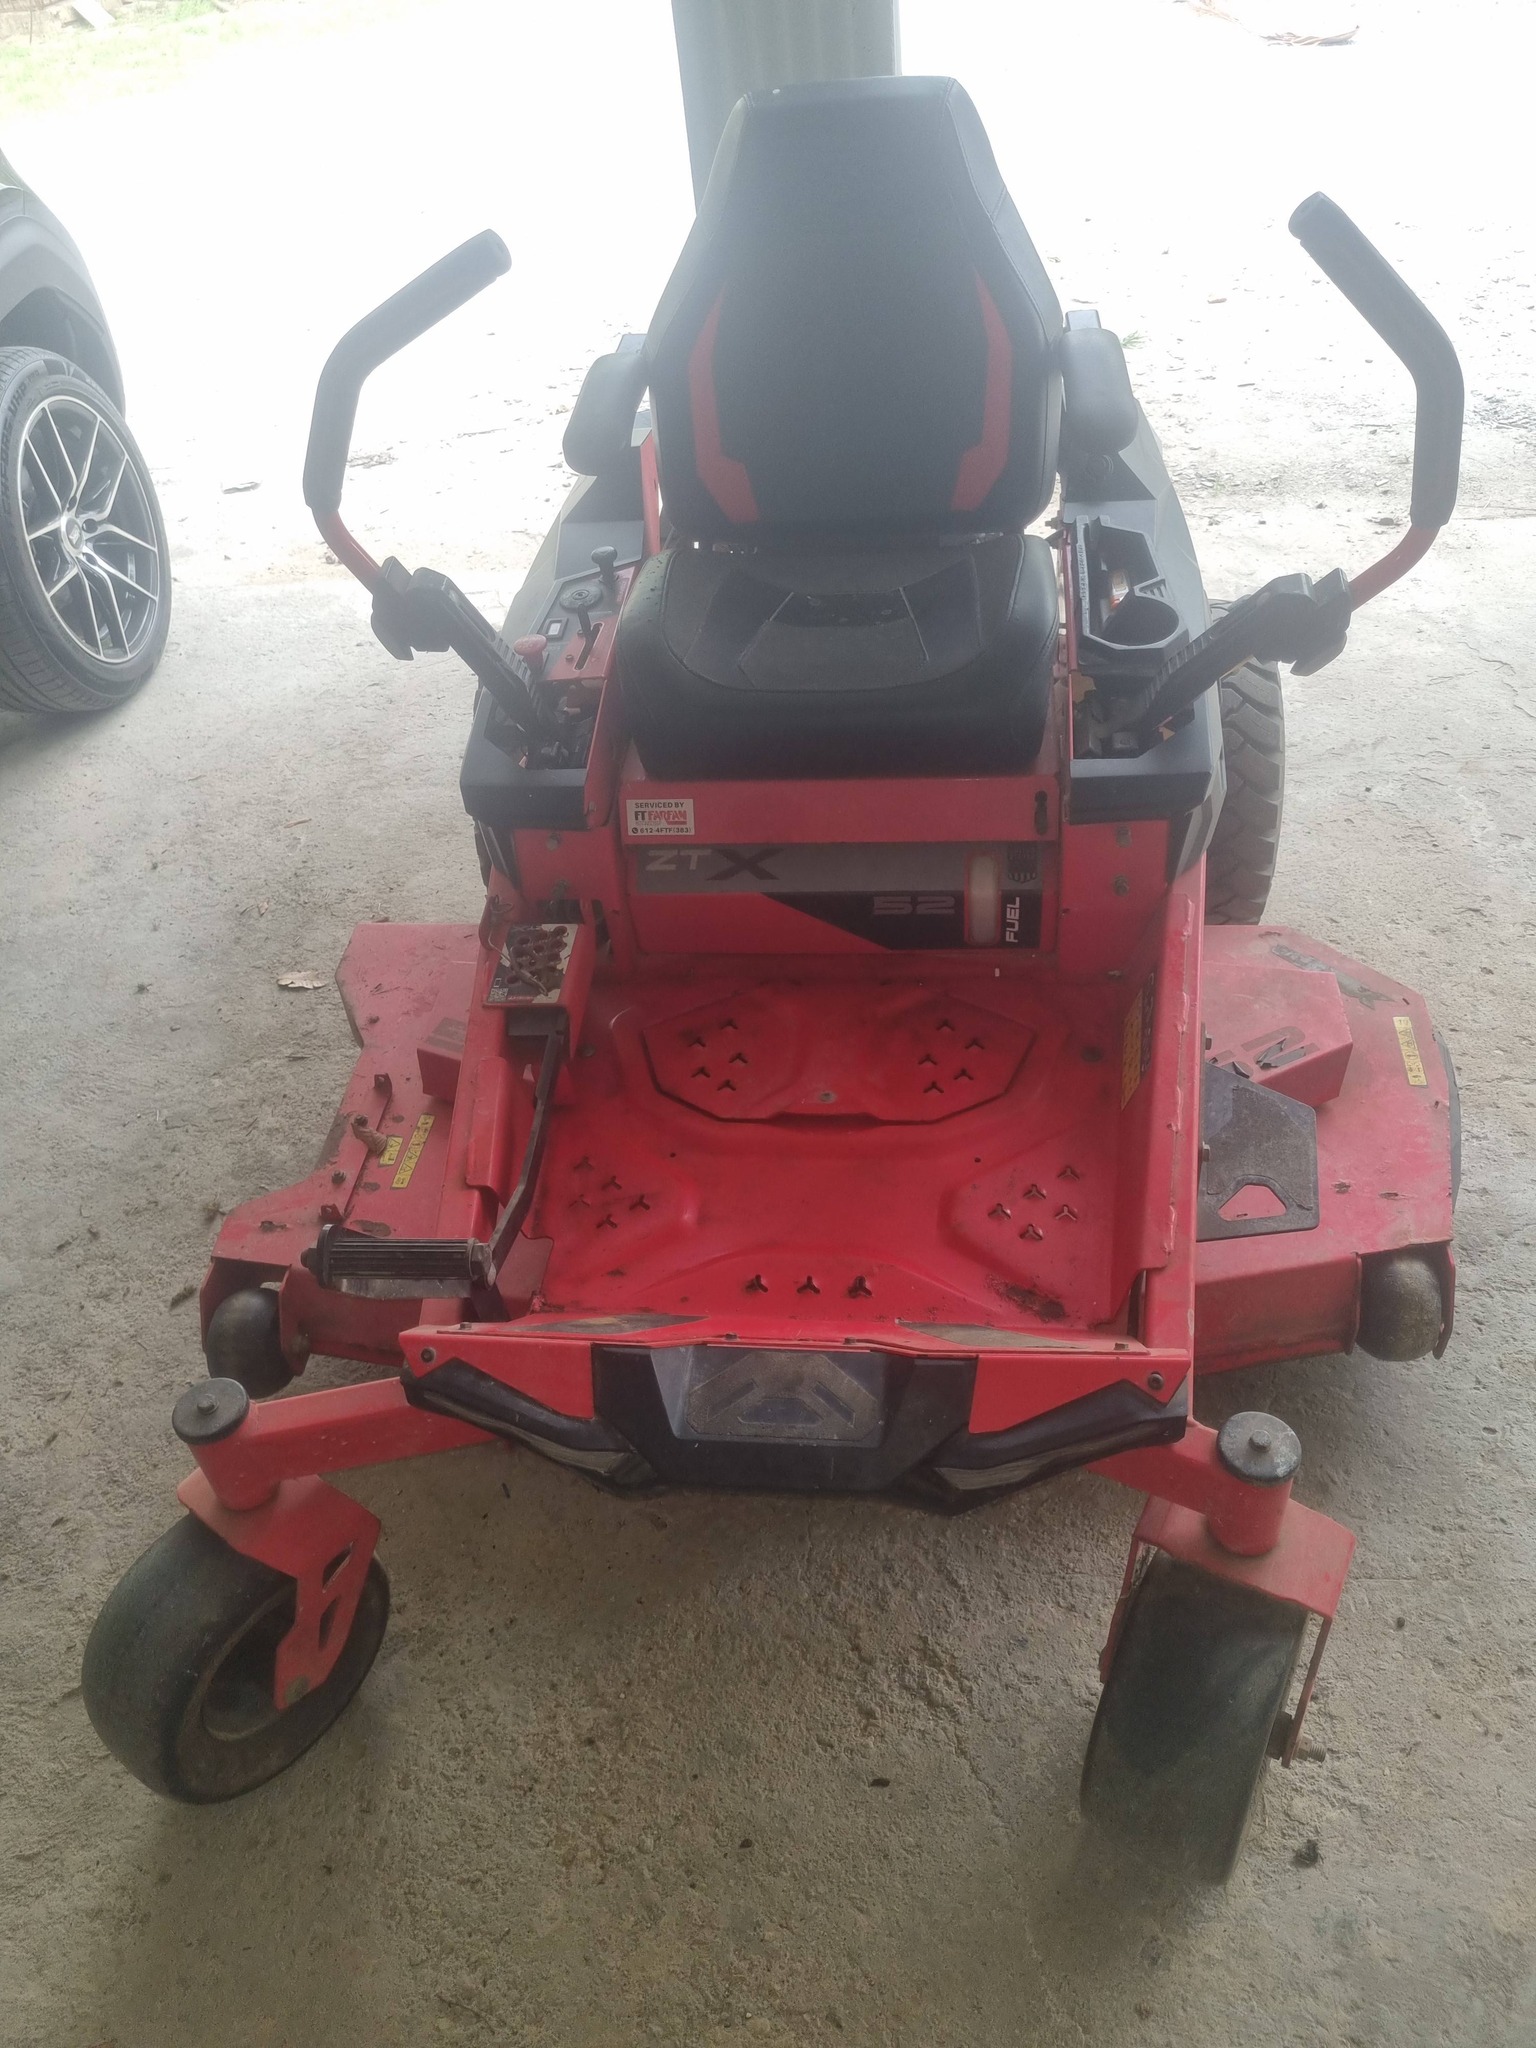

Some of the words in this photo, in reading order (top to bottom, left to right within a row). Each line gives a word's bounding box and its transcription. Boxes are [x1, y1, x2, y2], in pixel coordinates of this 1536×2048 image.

[634, 811, 647, 820] FT
[873, 896, 955, 915] 52
[1006, 897, 1020, 943] FUEL
